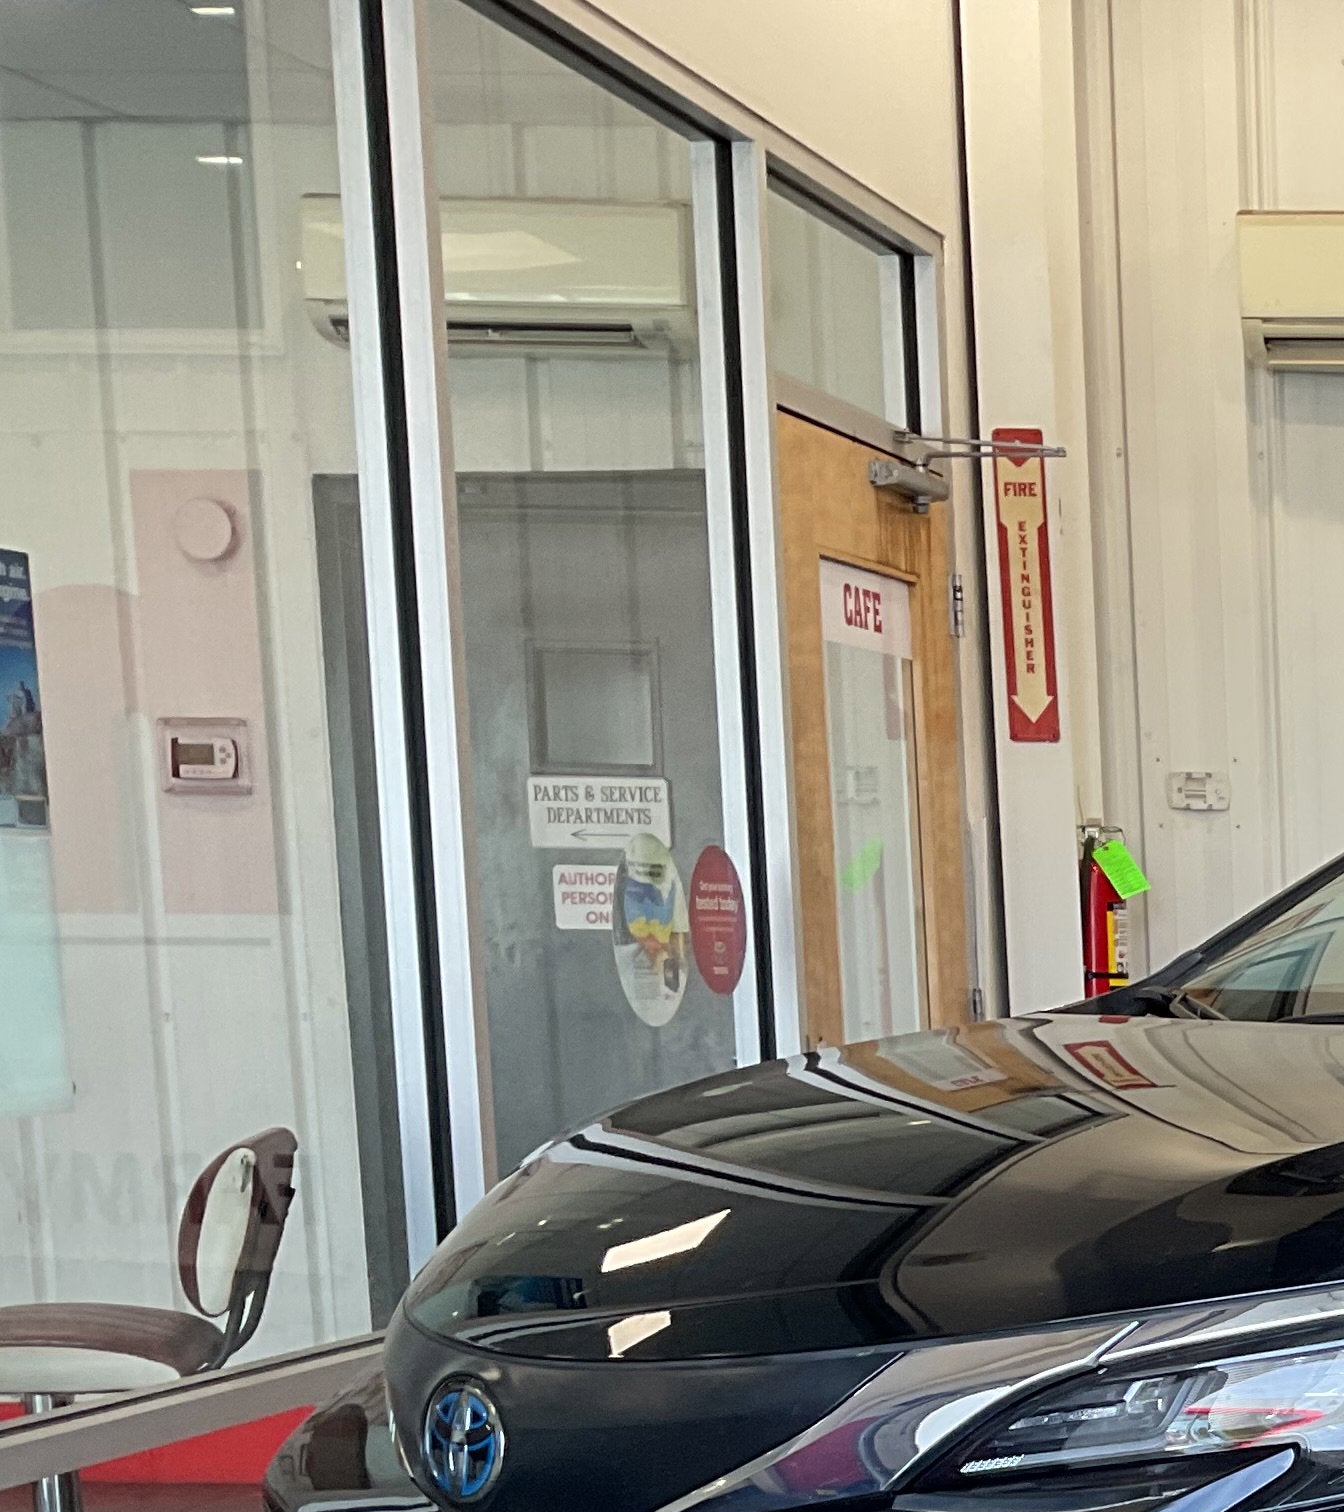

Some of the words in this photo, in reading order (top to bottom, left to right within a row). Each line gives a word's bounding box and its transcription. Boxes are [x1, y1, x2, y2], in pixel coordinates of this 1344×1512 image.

[1004, 482, 1037, 497] FIRE
[1017, 521, 1036, 674] EXTINGUISHER
[843, 583, 882, 634] CAFE
[534, 785, 579, 802] PARTS
[585, 785, 595, 802] &
[600, 785, 662, 803] SERVICE
[547, 806, 652, 825] DEPARTMENTS
[559, 873, 616, 886] AUTHOR
[562, 891, 613, 905] PERSO
[586, 911, 612, 924] ON
